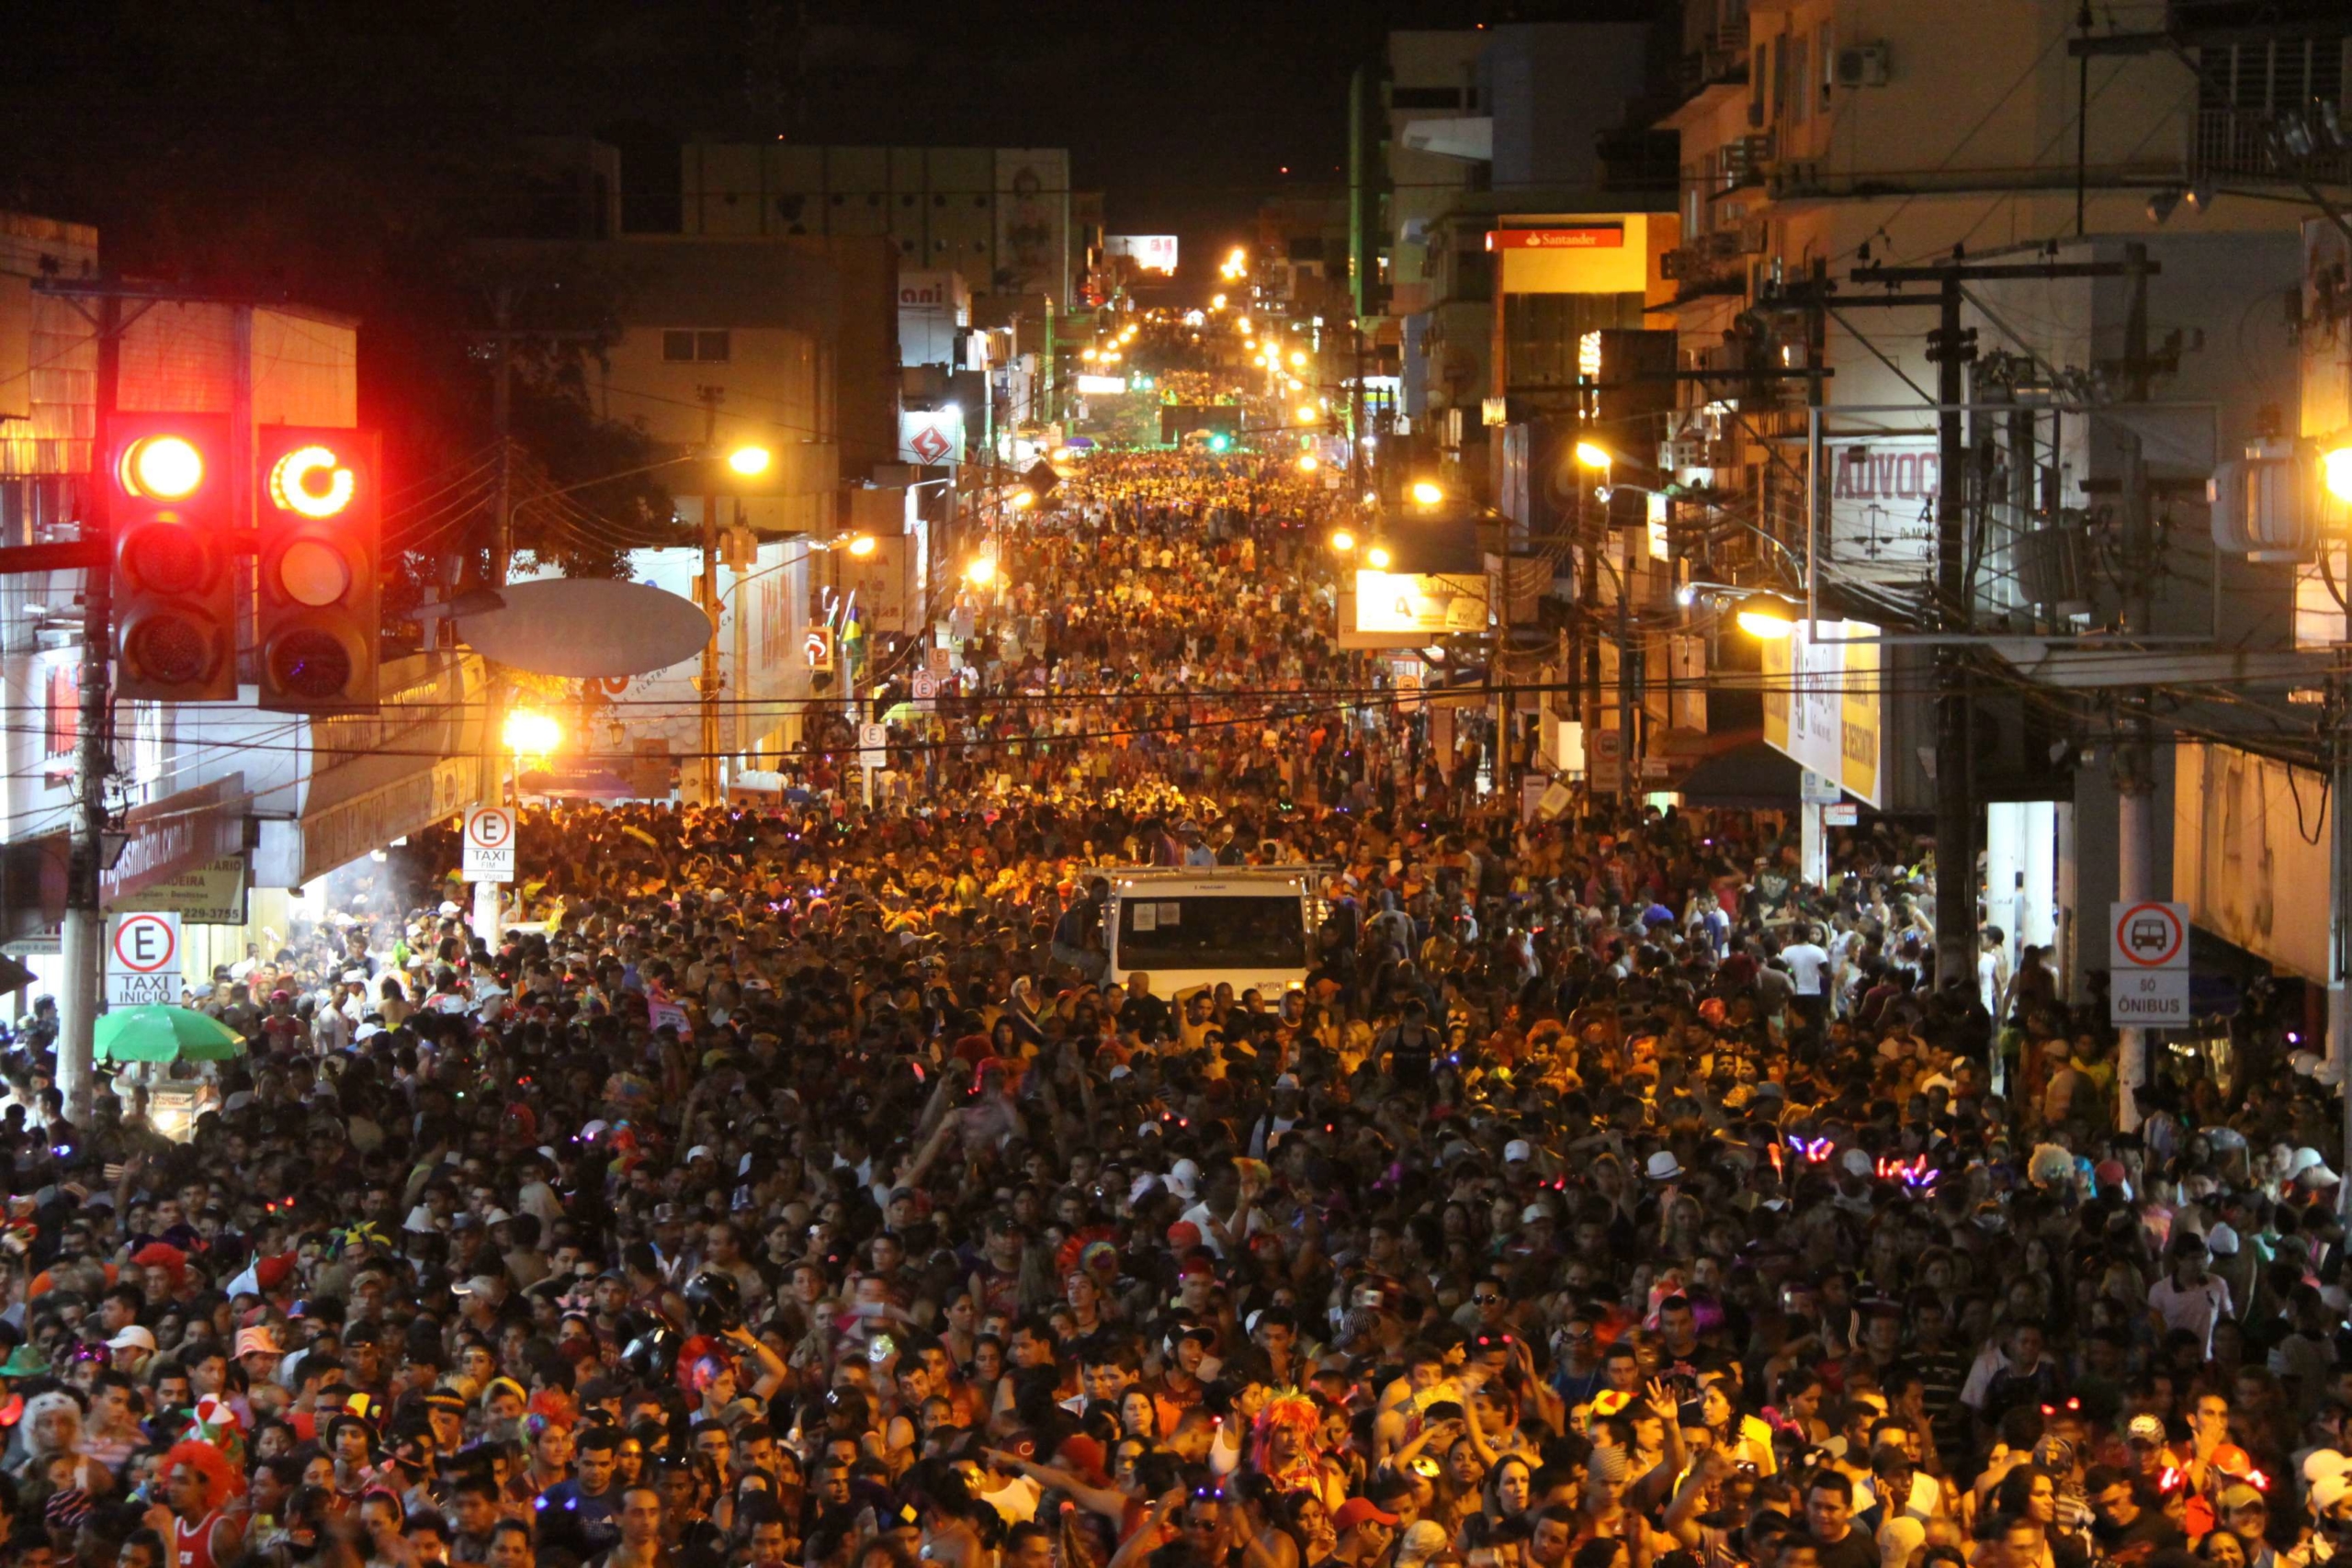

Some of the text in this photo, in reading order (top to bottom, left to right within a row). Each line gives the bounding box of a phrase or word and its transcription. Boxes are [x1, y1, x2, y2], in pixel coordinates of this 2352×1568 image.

[1542, 232, 1597, 245] Santander
[869, 728, 876, 741] E
[483, 816, 497, 840] E
[473, 851, 506, 862] TAXI
[184, 908, 239, 919] 229-3755
[135, 926, 155, 960] E
[121, 976, 168, 990] TAXI
[2140, 976, 2156, 992] SÓ
[2118, 995, 2180, 1013] ÔNIBUS
